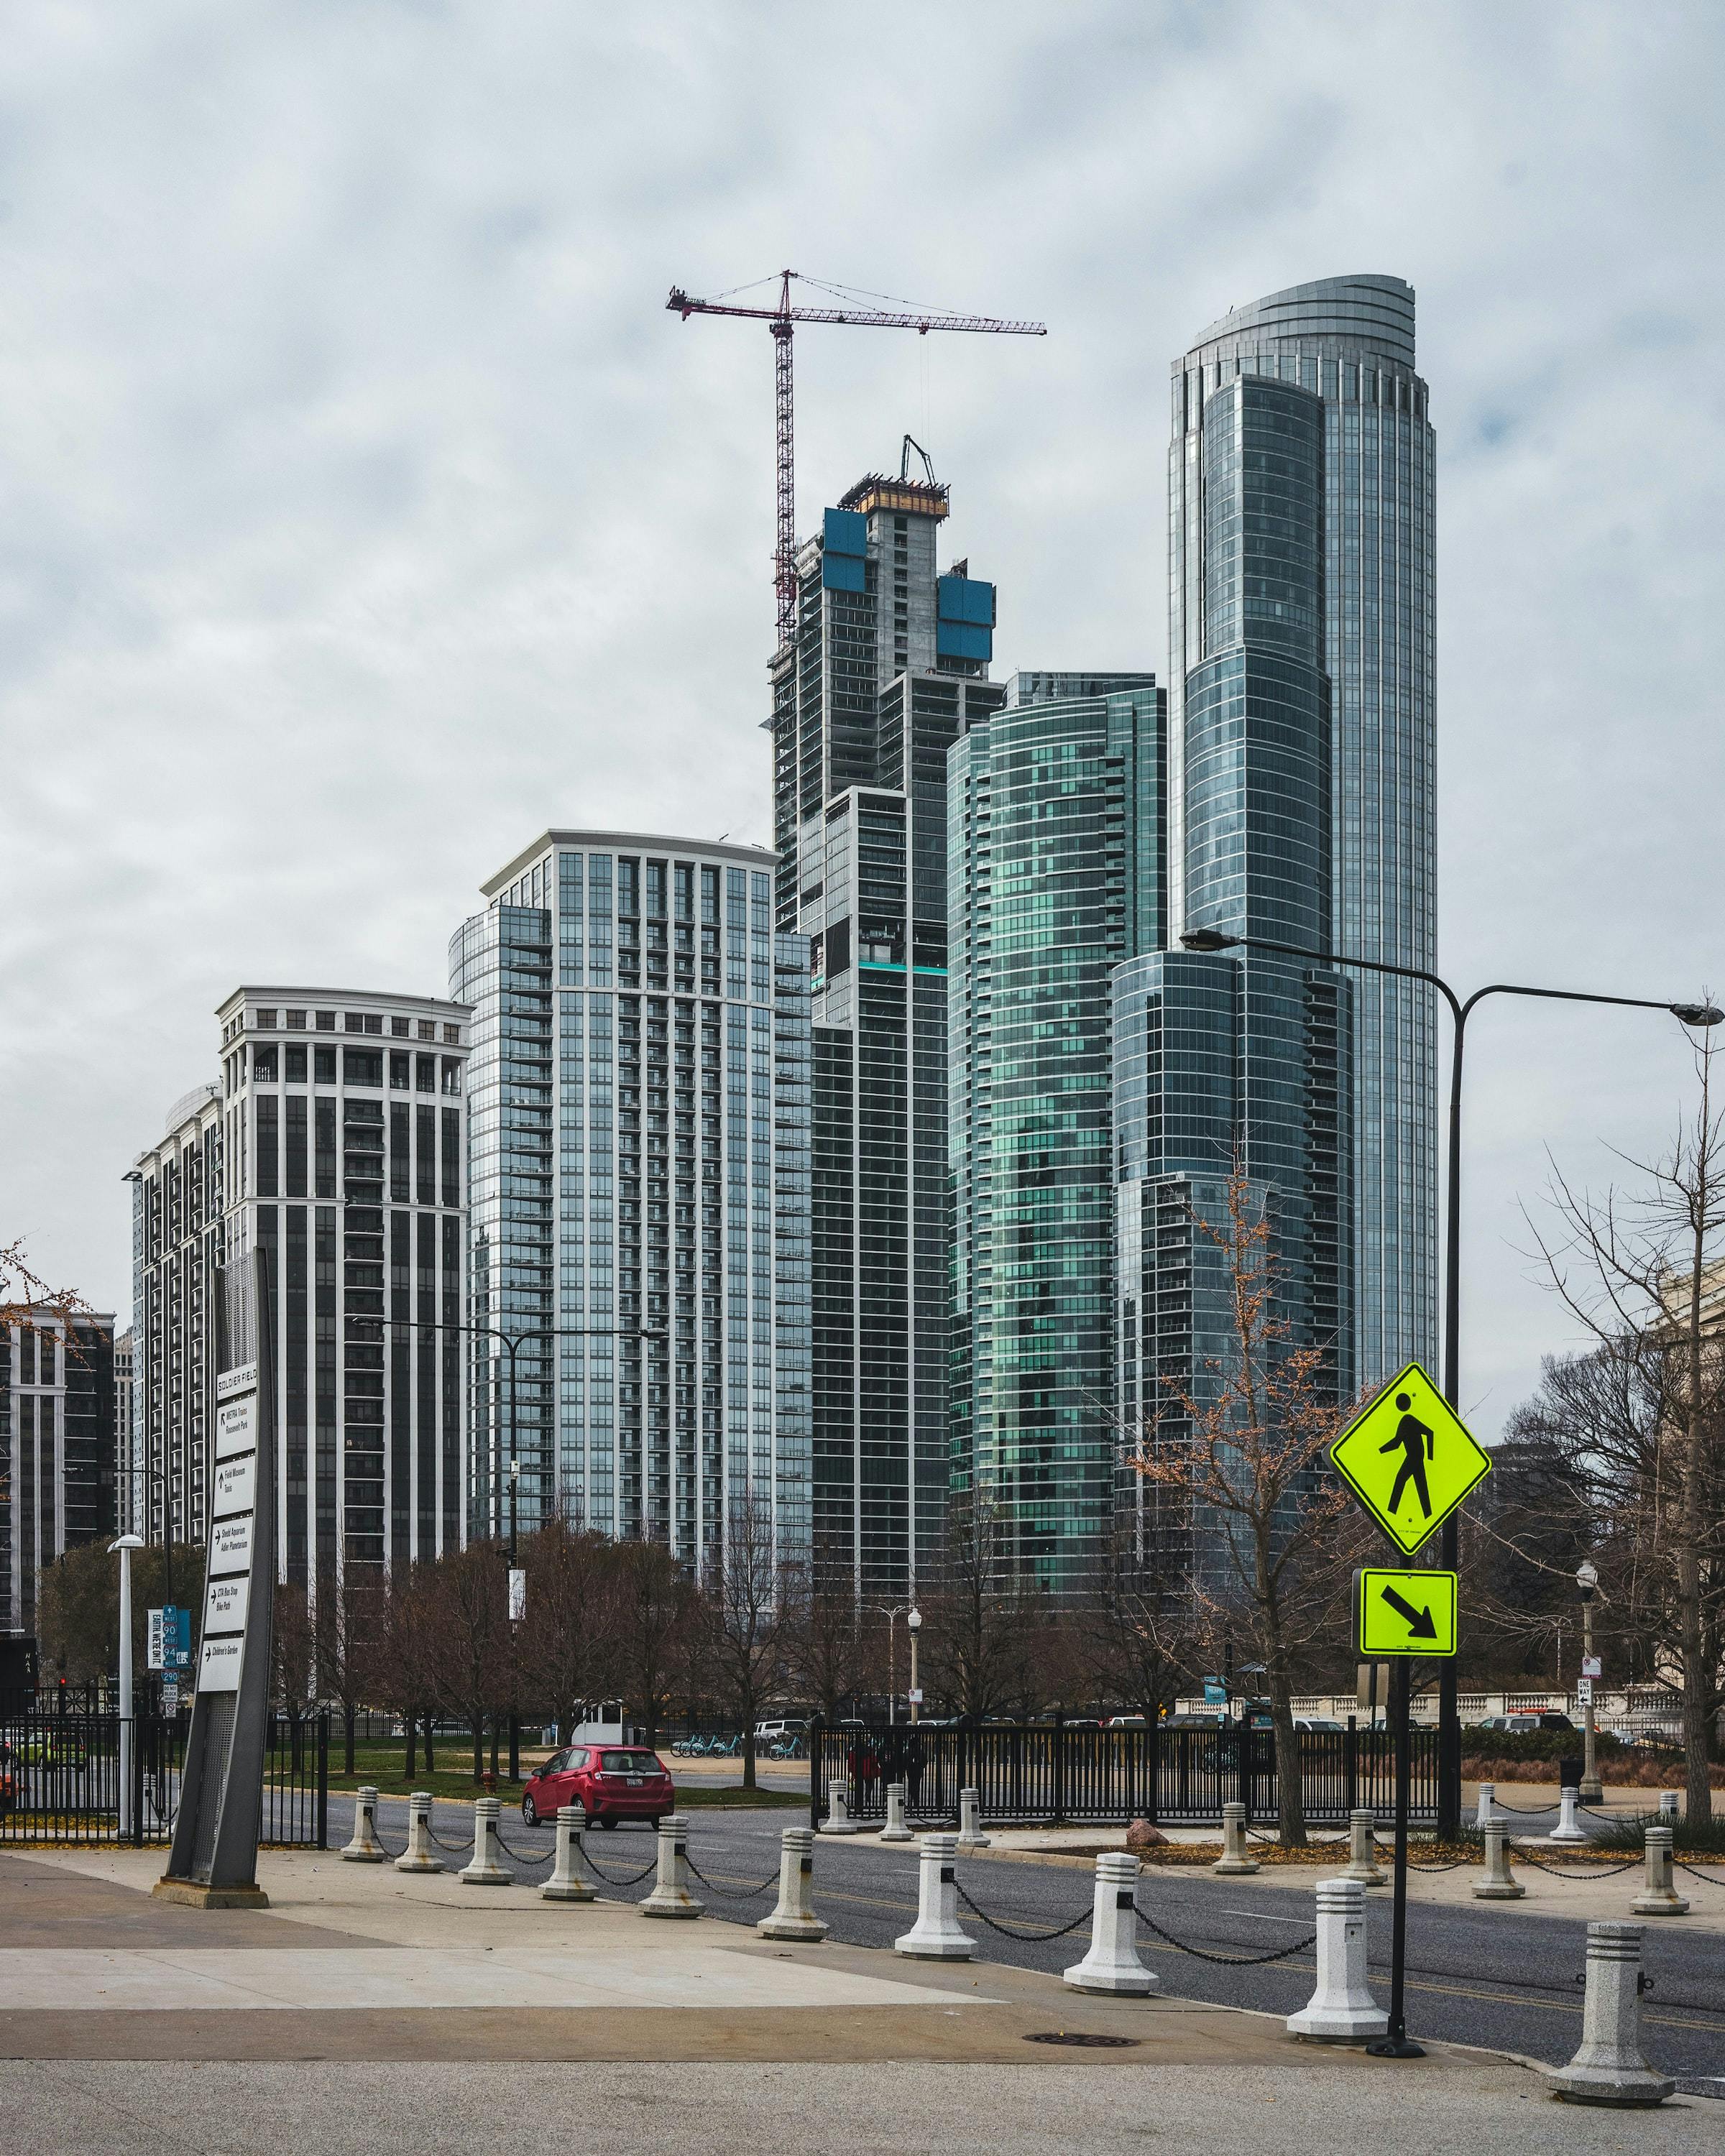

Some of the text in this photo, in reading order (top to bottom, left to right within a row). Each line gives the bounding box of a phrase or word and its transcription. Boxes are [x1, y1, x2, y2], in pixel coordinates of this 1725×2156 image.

[218, 1368, 257, 1391] SOLDIER FIELD
[226, 1407, 247, 1420] METRA Trains
[226, 1422, 240, 1434] Roosevelt
[232, 1468, 245, 1477] Museum
[221, 1526, 245, 1538] Shedd Aquarium
[221, 1540, 247, 1552] Adler Planetarium
[213, 1645, 238, 1656] Children's Garden
[164, 1672, 178, 1681] 290
